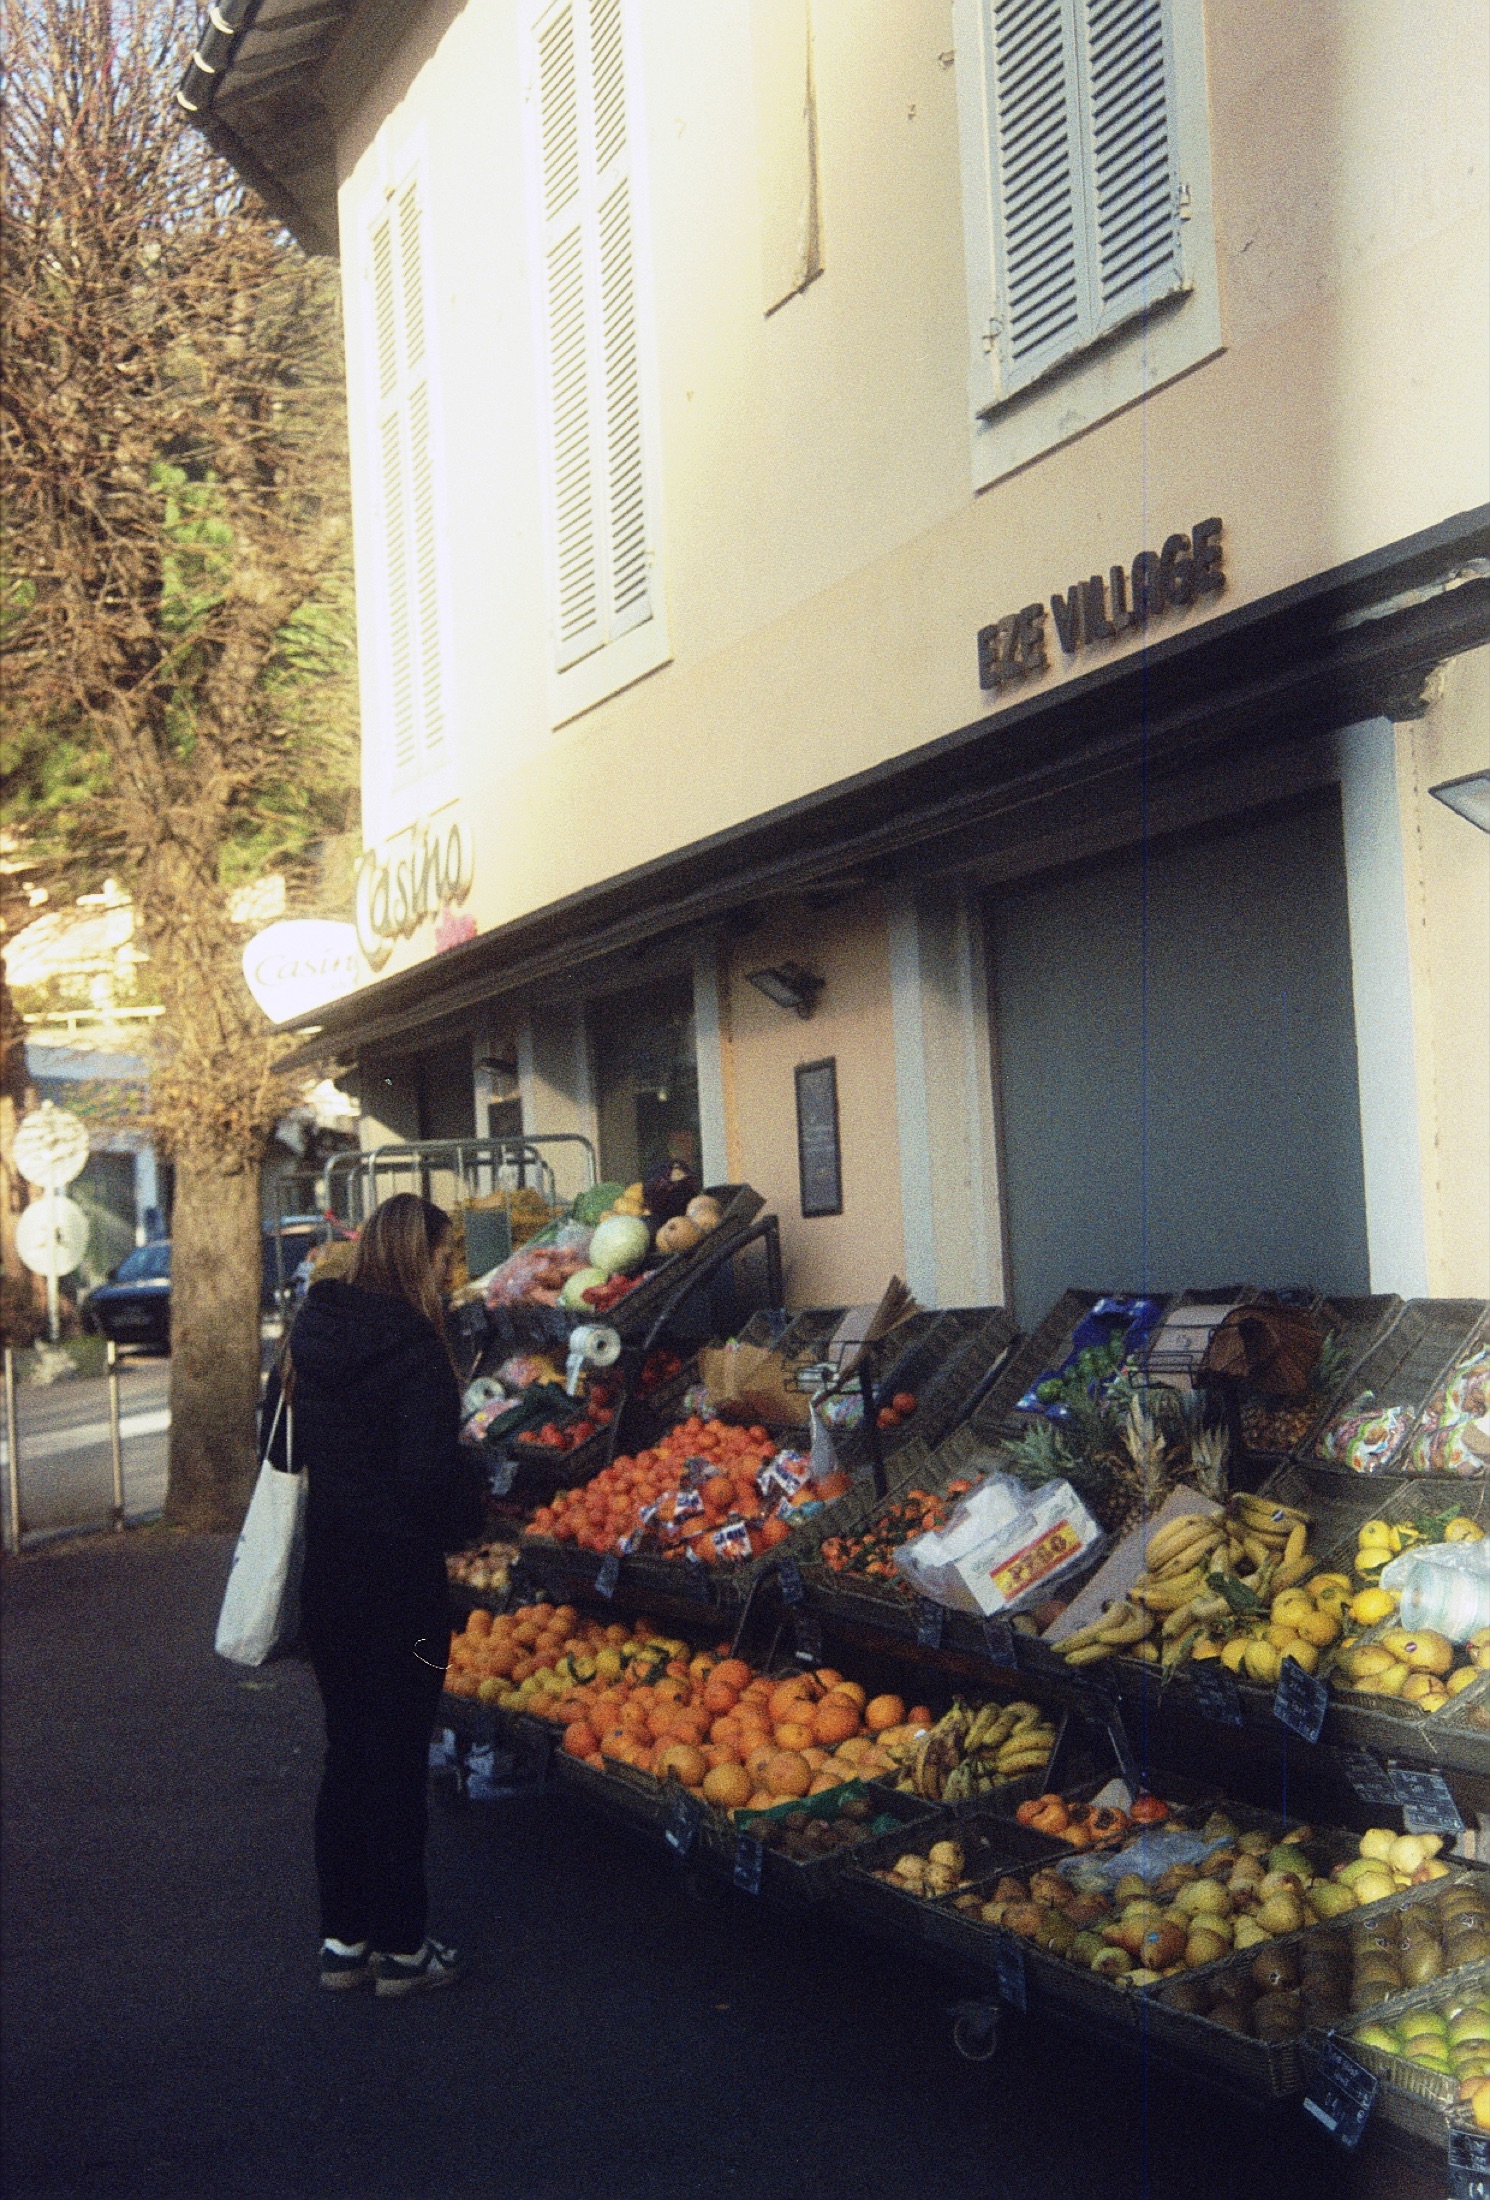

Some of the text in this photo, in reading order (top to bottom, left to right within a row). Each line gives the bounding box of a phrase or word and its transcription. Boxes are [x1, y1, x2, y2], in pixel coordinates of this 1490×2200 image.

[1050, 517, 1226, 654] VILLAGE
[356, 818, 474, 973] Casino
[253, 946, 358, 988] Casin
